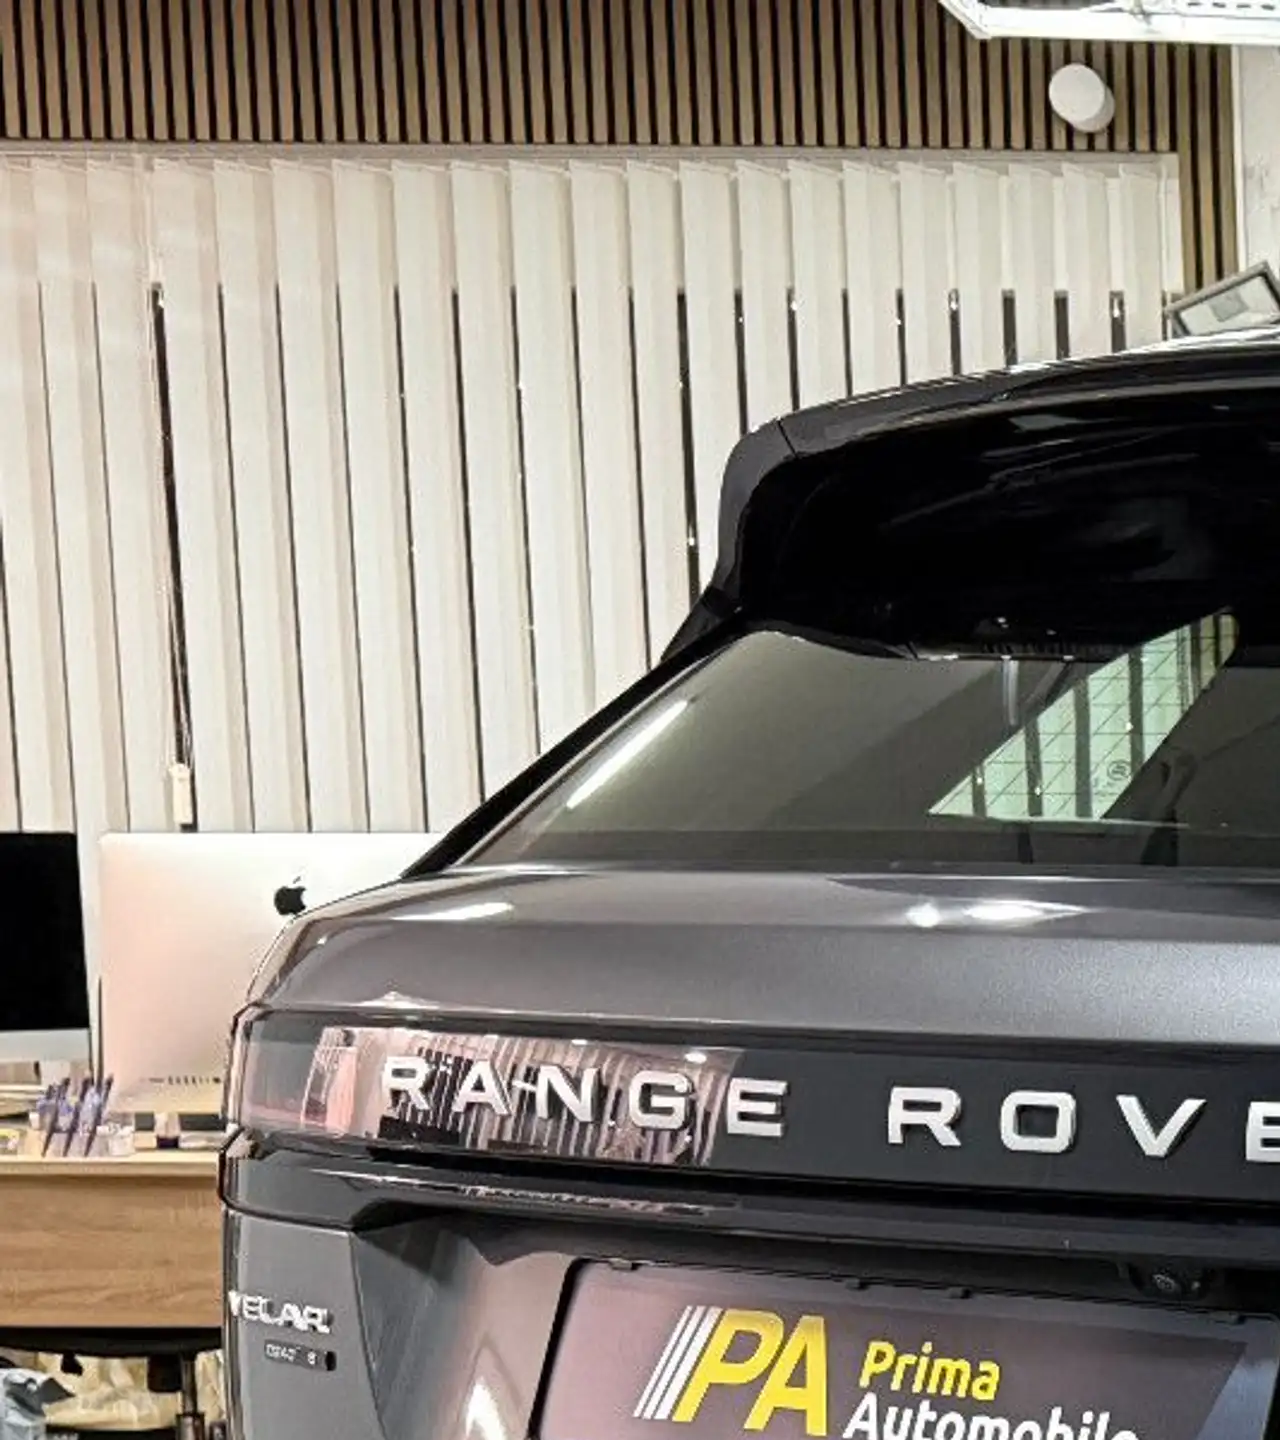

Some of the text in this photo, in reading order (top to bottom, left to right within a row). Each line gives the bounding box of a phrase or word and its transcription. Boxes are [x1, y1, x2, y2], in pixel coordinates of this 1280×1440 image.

[380, 1054, 789, 1138] RANGE
[228, 1289, 332, 1335] VELAR
[671, 1307, 828, 1437] PA
[858, 1340, 1001, 1401] Prima
